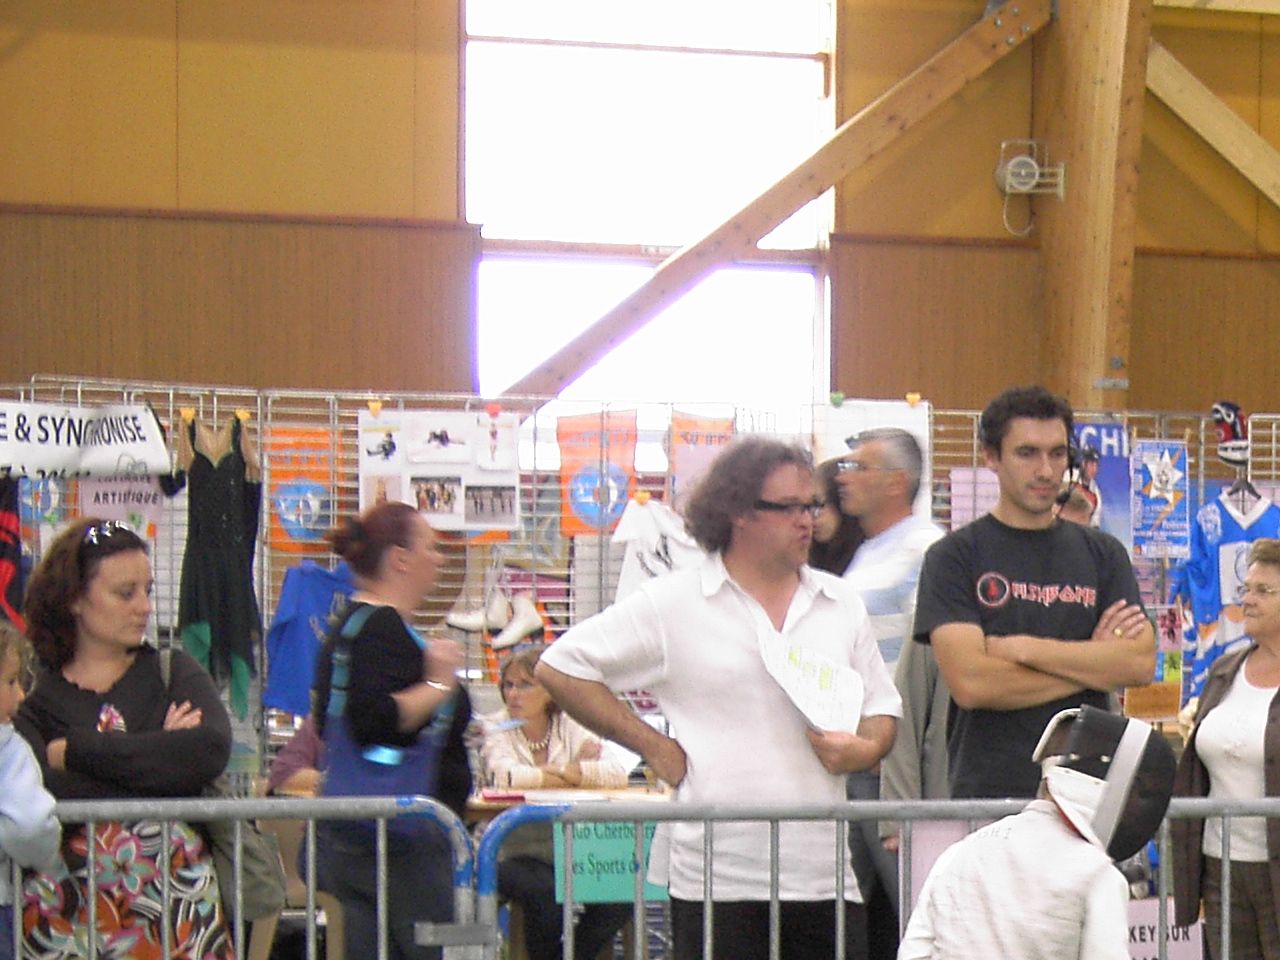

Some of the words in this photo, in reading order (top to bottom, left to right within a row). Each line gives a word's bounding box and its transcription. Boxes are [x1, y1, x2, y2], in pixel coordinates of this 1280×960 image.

[15, 412, 31, 443] &
[37, 415, 147, 447] SYNCRONISE
[587, 852, 626, 882] Sports
[1165, 925, 1190, 941] UR
